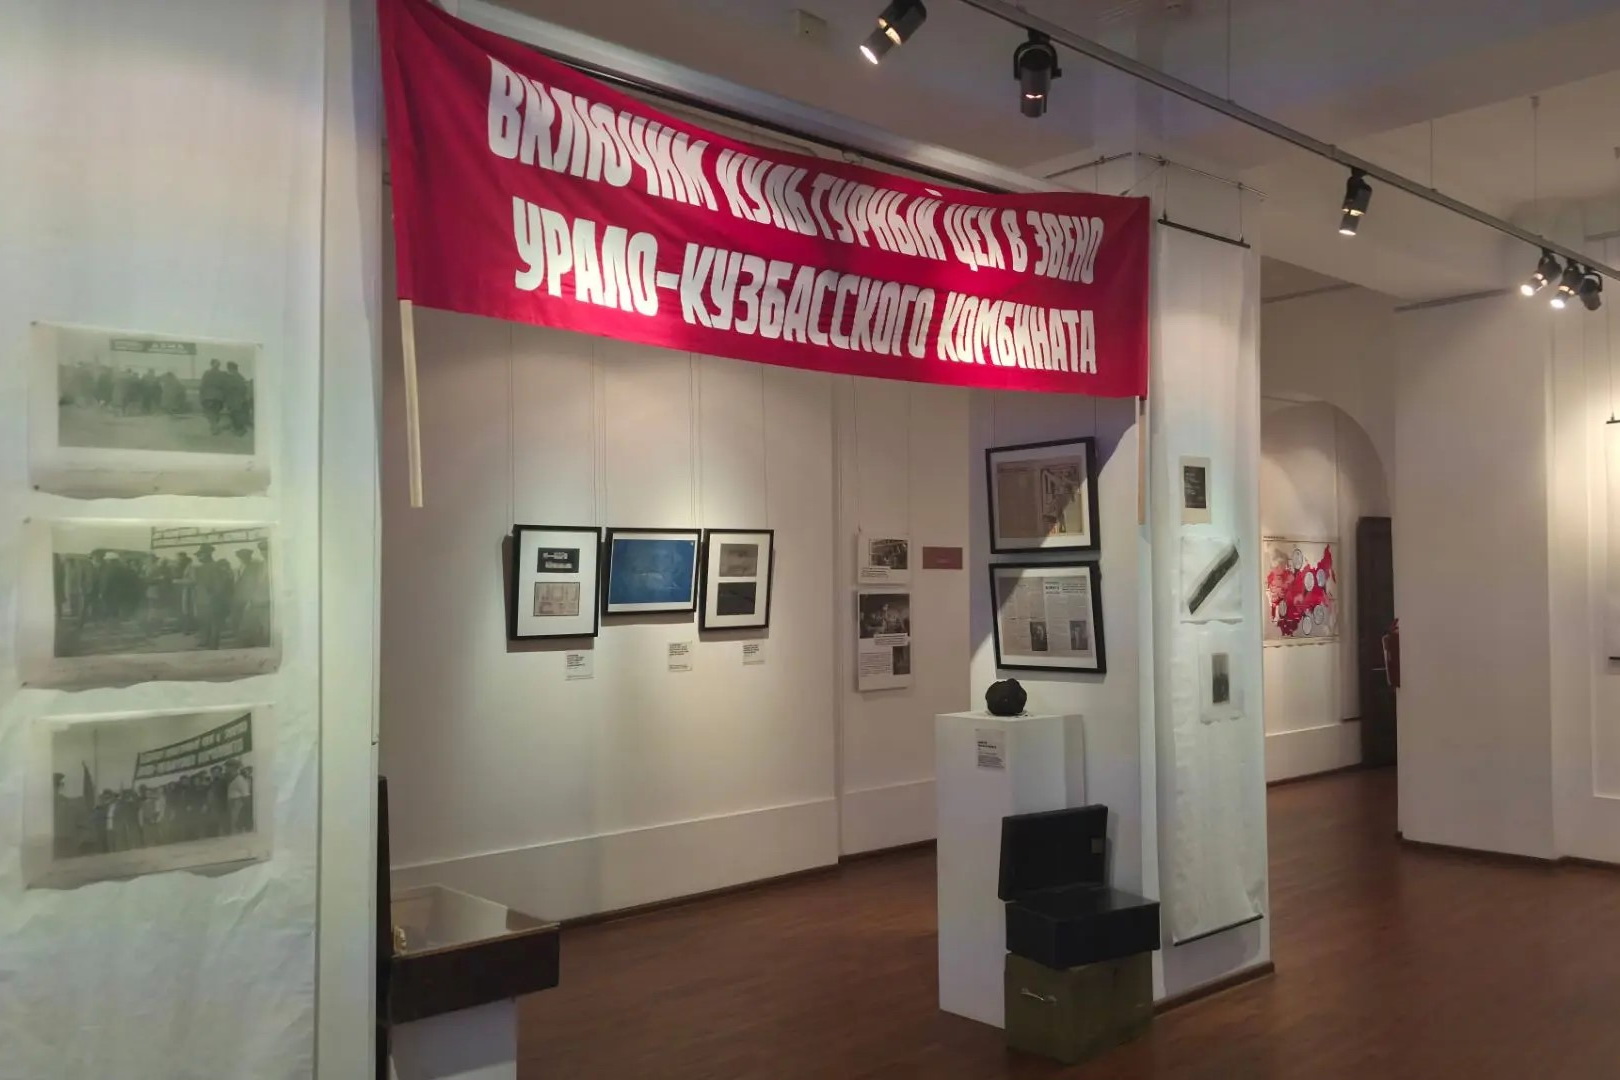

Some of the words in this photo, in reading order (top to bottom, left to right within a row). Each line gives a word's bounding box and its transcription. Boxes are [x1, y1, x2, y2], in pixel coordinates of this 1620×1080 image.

[486, 54, 718, 211] ВКЛЮЧИМ
[715, 147, 947, 261] КУЛЬТУРНЫЙ
[943, 203, 1005, 272] ЦЕХ
[1000, 208, 1028, 273] В
[1026, 210, 1104, 284] ЗВЕНО
[512, 195, 935, 359] УРАЛО-КУЗБАССКОГО
[937, 291, 1097, 374] КОМБИНАТА
